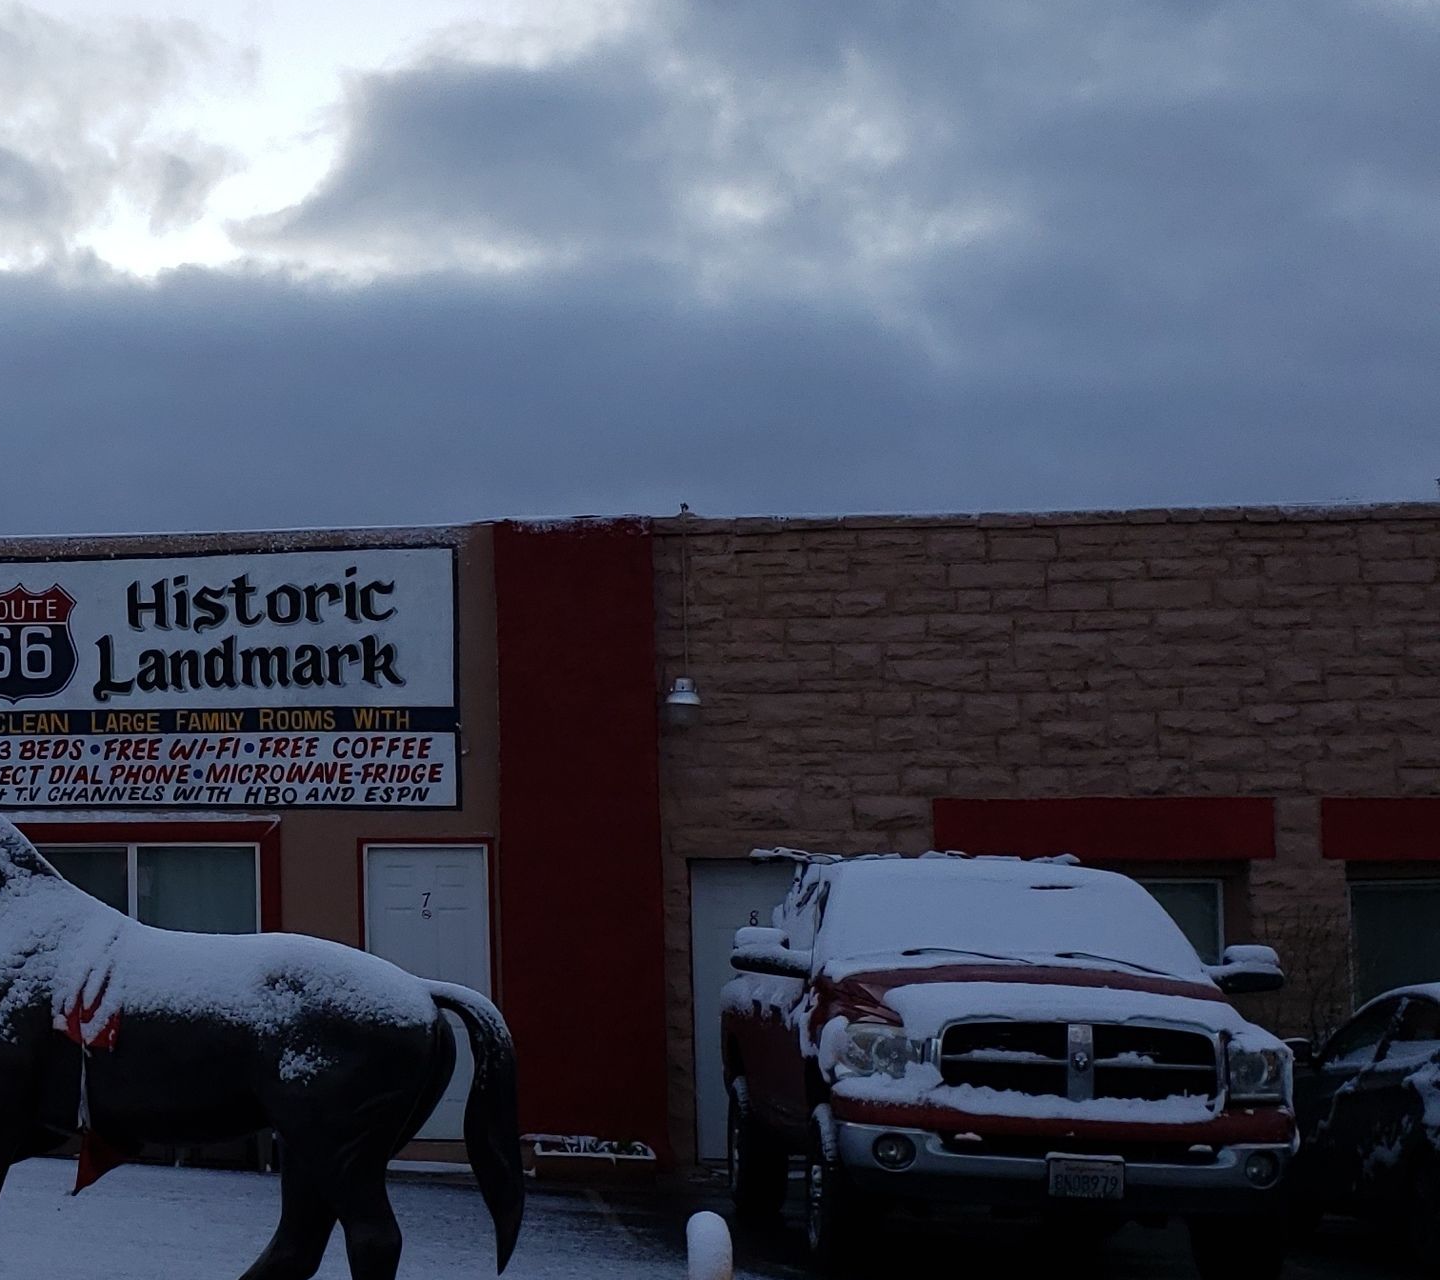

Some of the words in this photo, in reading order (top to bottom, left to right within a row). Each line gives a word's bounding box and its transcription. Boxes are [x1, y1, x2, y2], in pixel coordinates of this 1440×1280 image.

[125, 566, 397, 634] Historic
[92, 630, 407, 703] Landmark
[91, 711, 161, 733] LARGE
[176, 710, 244, 732] FAMILY
[259, 708, 337, 731] ROOMS
[352, 707, 410, 730] WITH
[19, 739, 85, 761] BEDS
[103, 738, 163, 761] FREE
[169, 737, 241, 760] WI-FI
[258, 737, 320, 760] FREE
[332, 736, 433, 760] COFFEE
[49, 764, 104, 785] DIAL
[109, 763, 192, 785] PHONE
[48, 785, 166, 802] CHANNELS
[172, 785, 233, 802] WITH
[244, 786, 298, 805] HBO
[305, 785, 356, 803] AND
[364, 785, 431, 803] ESPN
[421, 892, 431, 908] 7
[749, 910, 759, 927] 8
